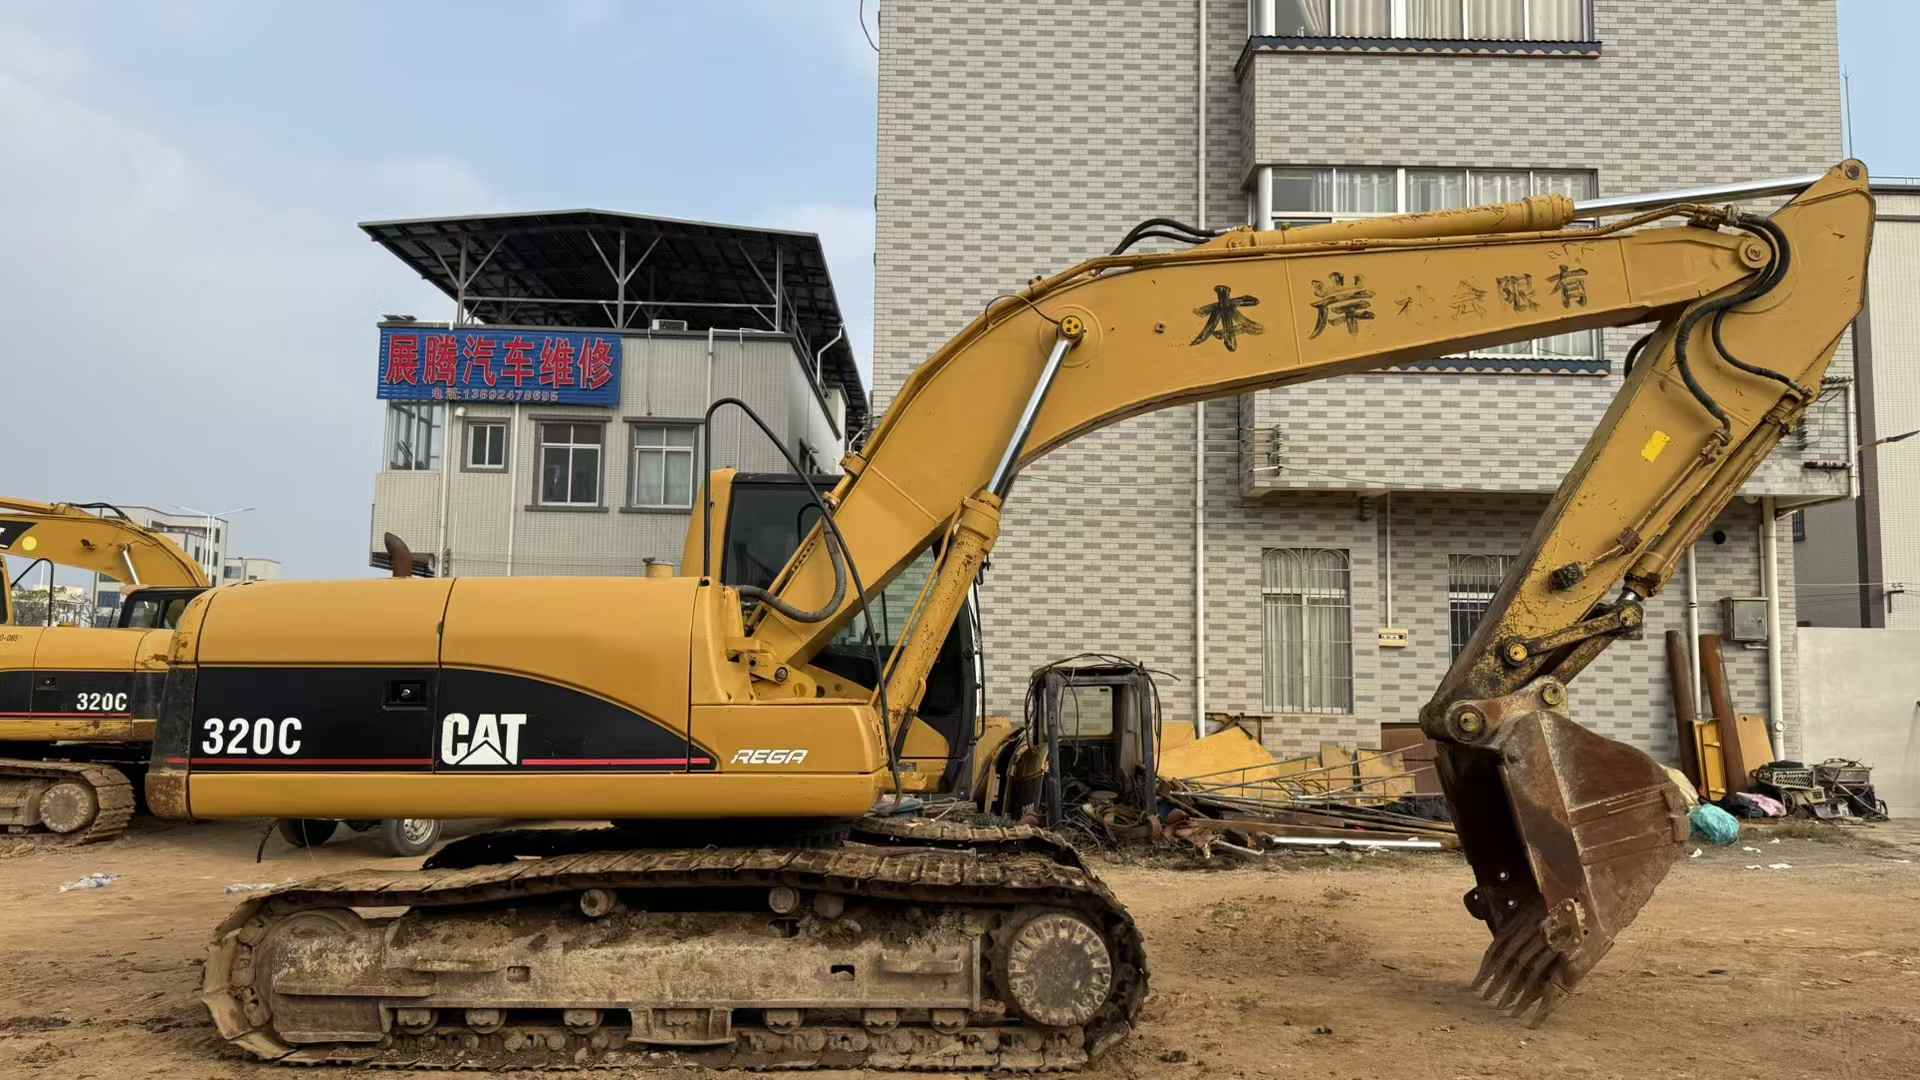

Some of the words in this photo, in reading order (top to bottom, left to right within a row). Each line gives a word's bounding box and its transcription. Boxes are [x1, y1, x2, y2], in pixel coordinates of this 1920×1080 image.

[385, 335, 613, 389] 展腾汽车维修
[76, 692, 128, 711] 320C
[202, 717, 303, 755] 320C
[441, 713, 527, 765] CAT
[730, 749, 809, 764] REGA
